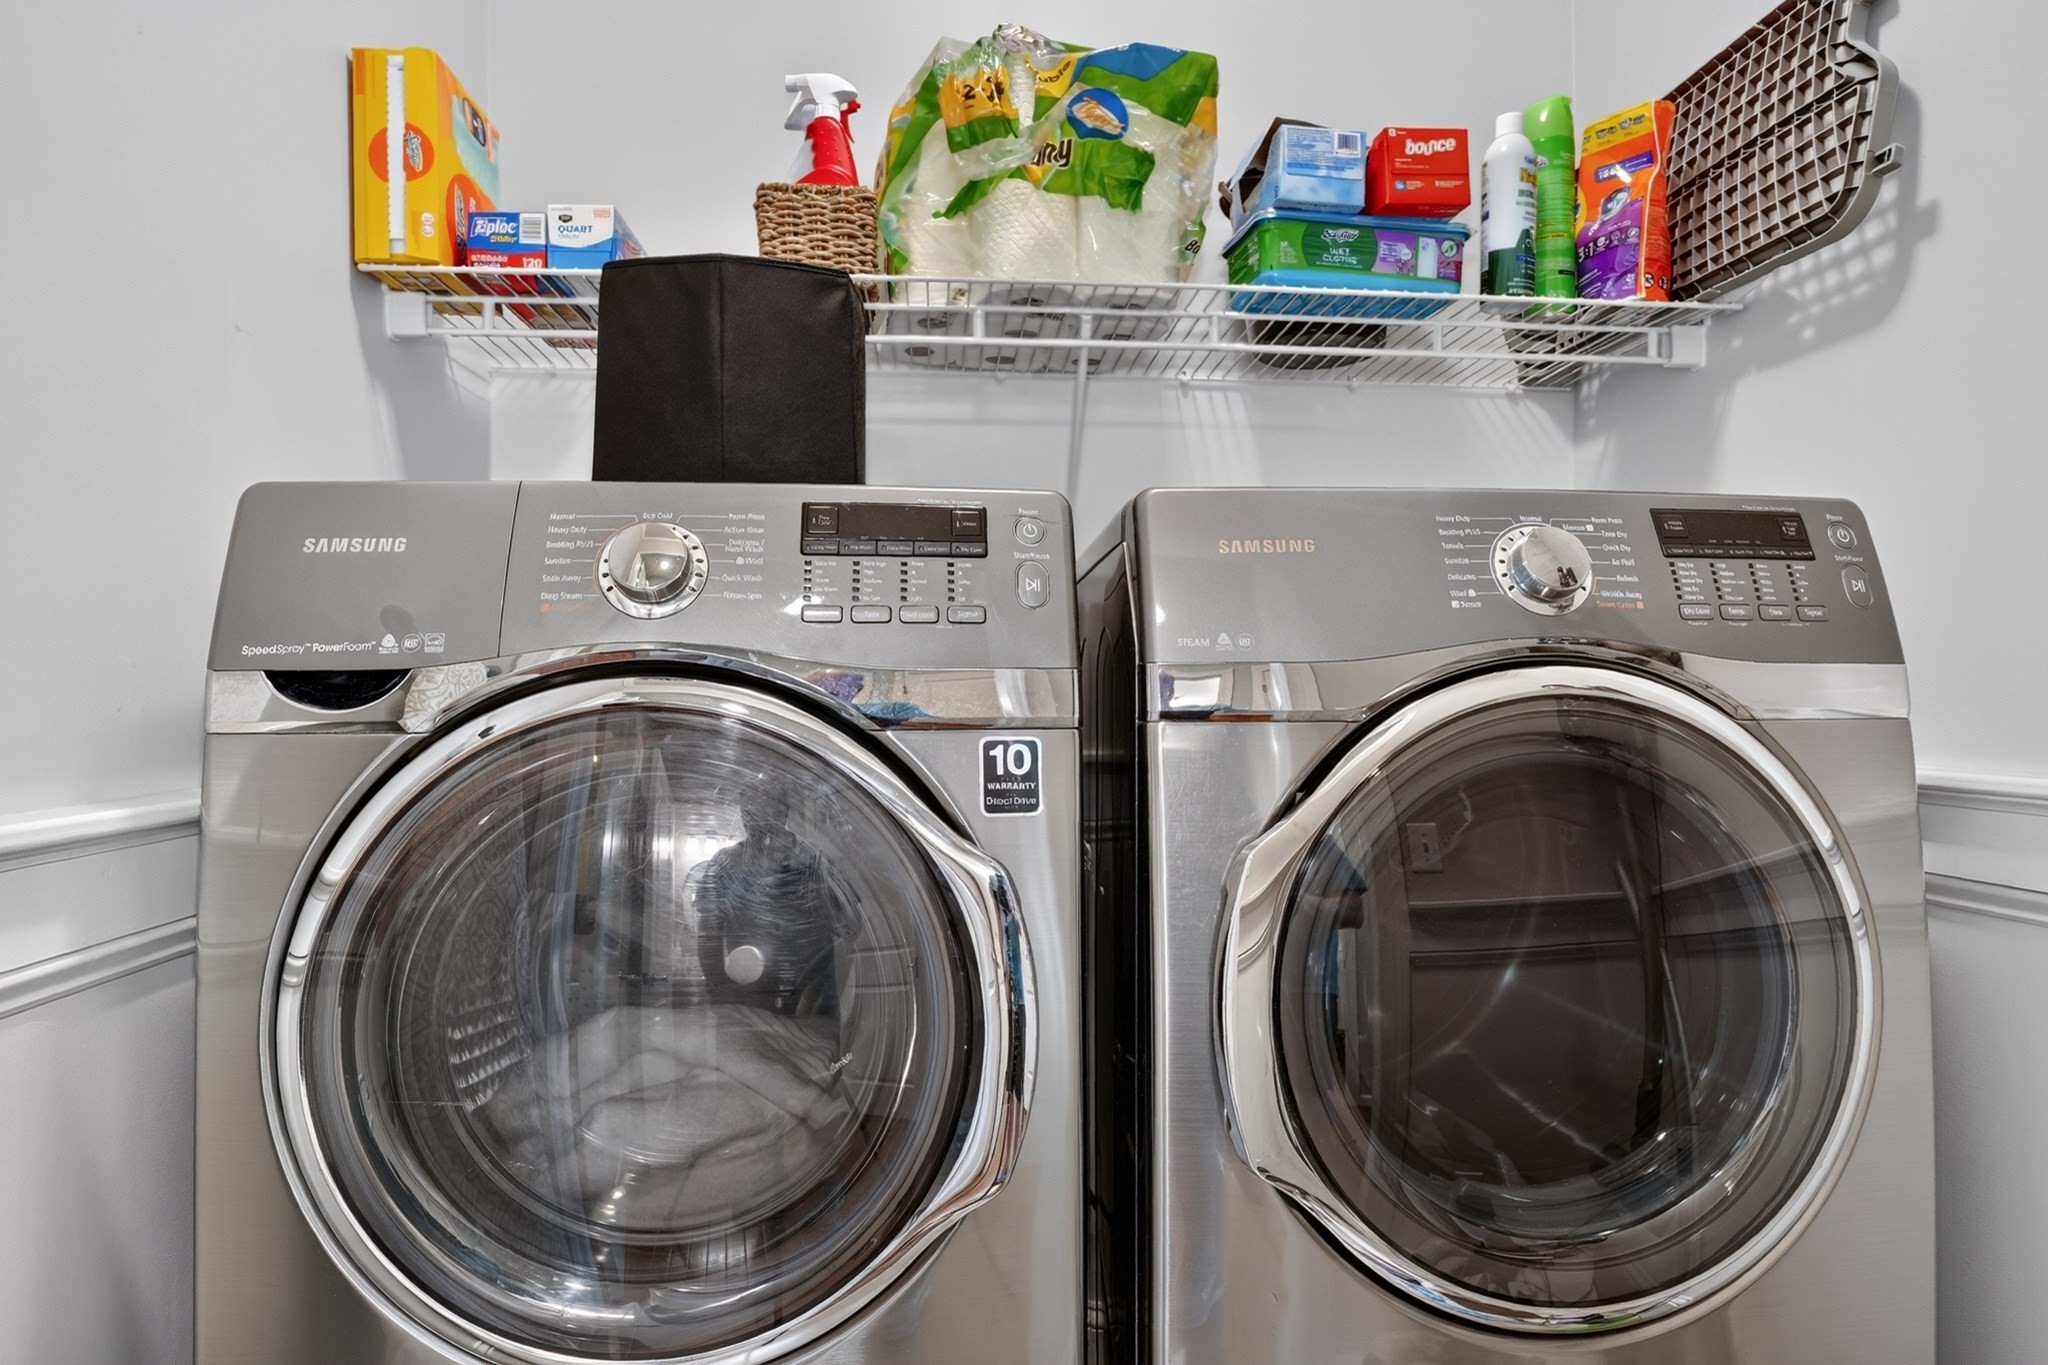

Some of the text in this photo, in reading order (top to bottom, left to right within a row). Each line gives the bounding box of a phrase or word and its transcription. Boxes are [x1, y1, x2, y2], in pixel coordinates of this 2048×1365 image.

[1405, 138, 1457, 156] bounce
[473, 218, 518, 237] Ziploc
[303, 537, 408, 553] SAMSUNG
[1218, 539, 1316, 554] SAMSUNG
[1177, 638, 1210, 647] STEAM
[989, 743, 1032, 776] 10
[987, 782, 1037, 790] WARRANTY
